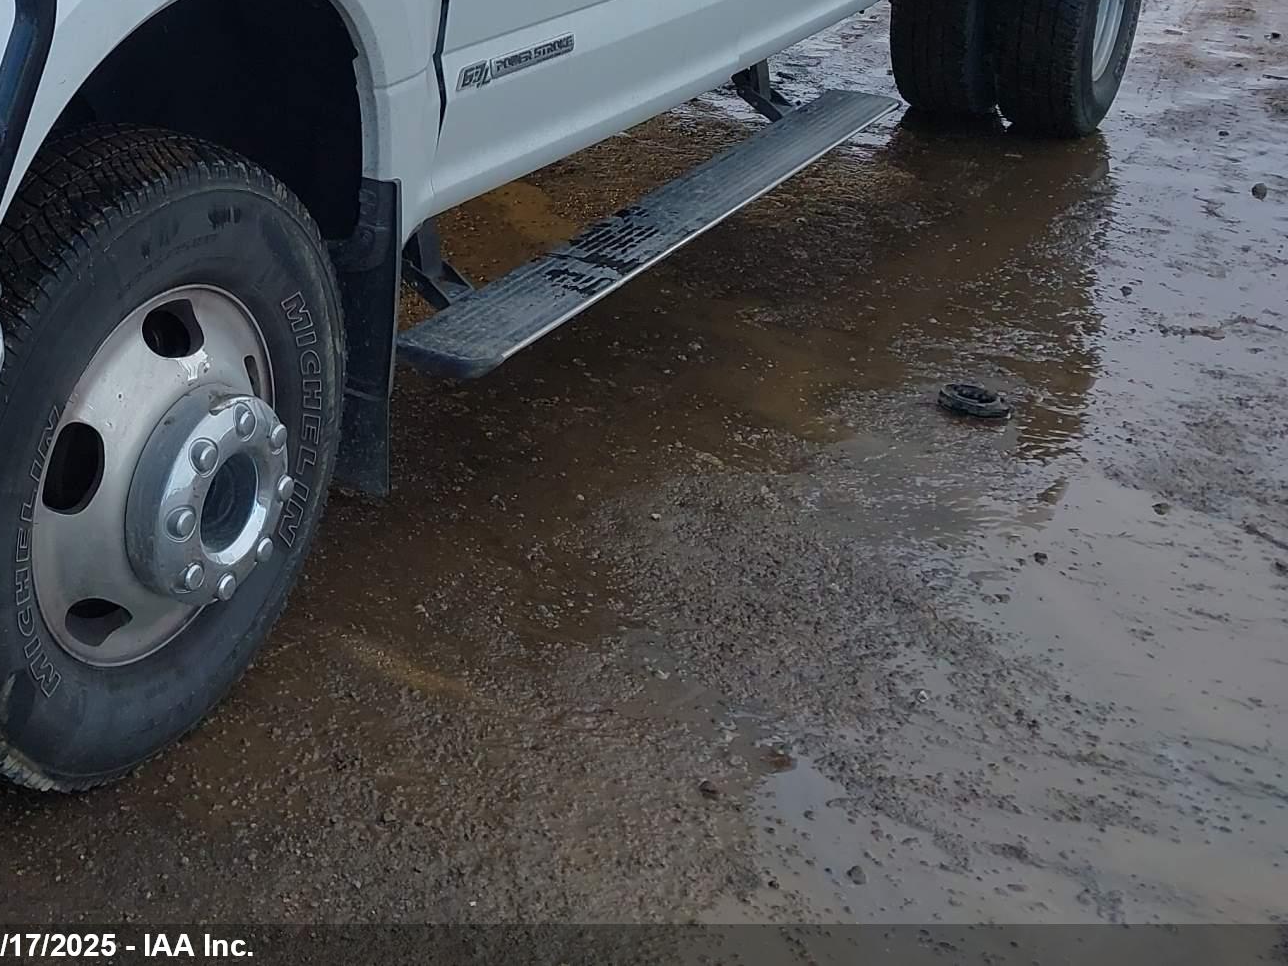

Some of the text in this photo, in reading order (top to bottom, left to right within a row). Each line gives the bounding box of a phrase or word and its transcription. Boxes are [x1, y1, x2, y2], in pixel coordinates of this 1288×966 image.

[495, 48, 533, 72] POWER
[533, 34, 574, 60] STROKE
[269, 290, 322, 548] MICHELIN
